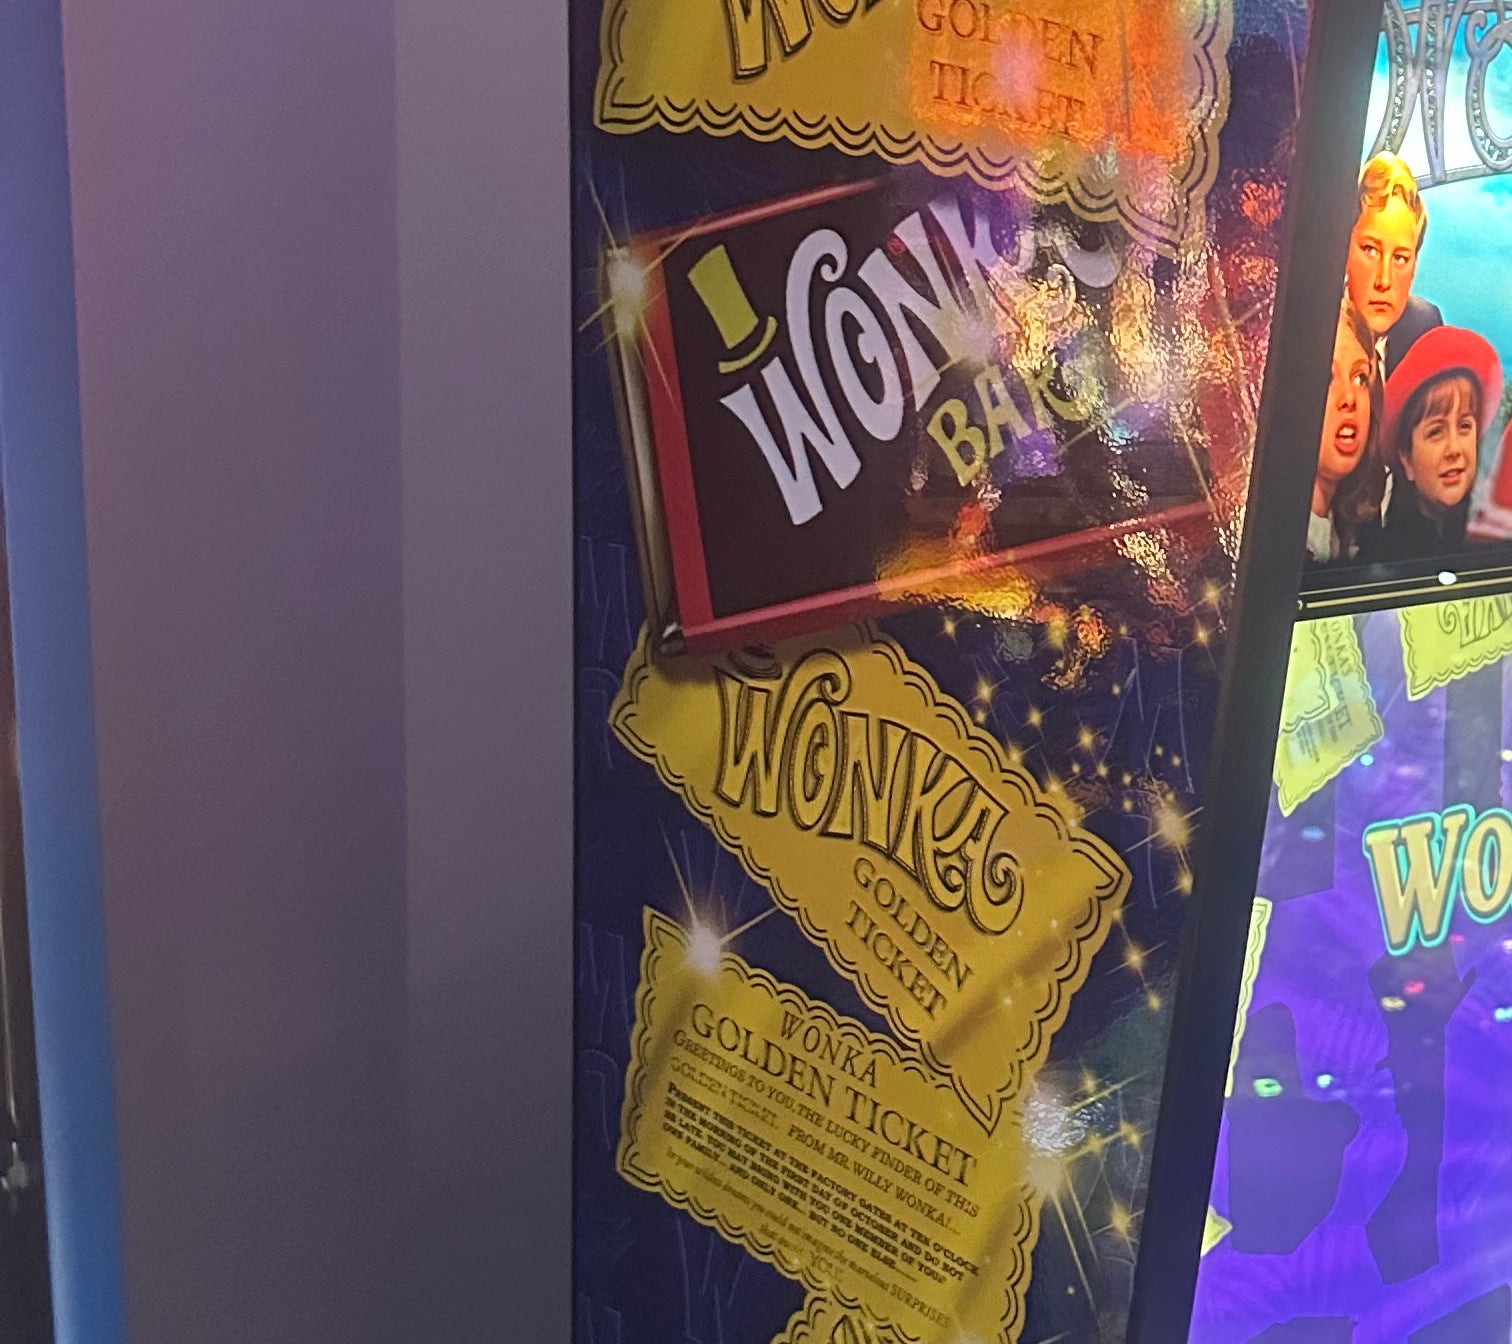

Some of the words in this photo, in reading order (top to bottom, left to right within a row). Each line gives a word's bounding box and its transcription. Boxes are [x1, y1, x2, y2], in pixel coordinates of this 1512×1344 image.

[929, 59, 1087, 141] TICET
[712, 647, 1024, 938] WONKA
[845, 898, 947, 1020] TICKET
[853, 856, 972, 993] GOLDEN
[691, 1003, 836, 1107] GOLDEN
[845, 1085, 977, 1187] TICKET
[781, 1011, 878, 1089] WONKA
